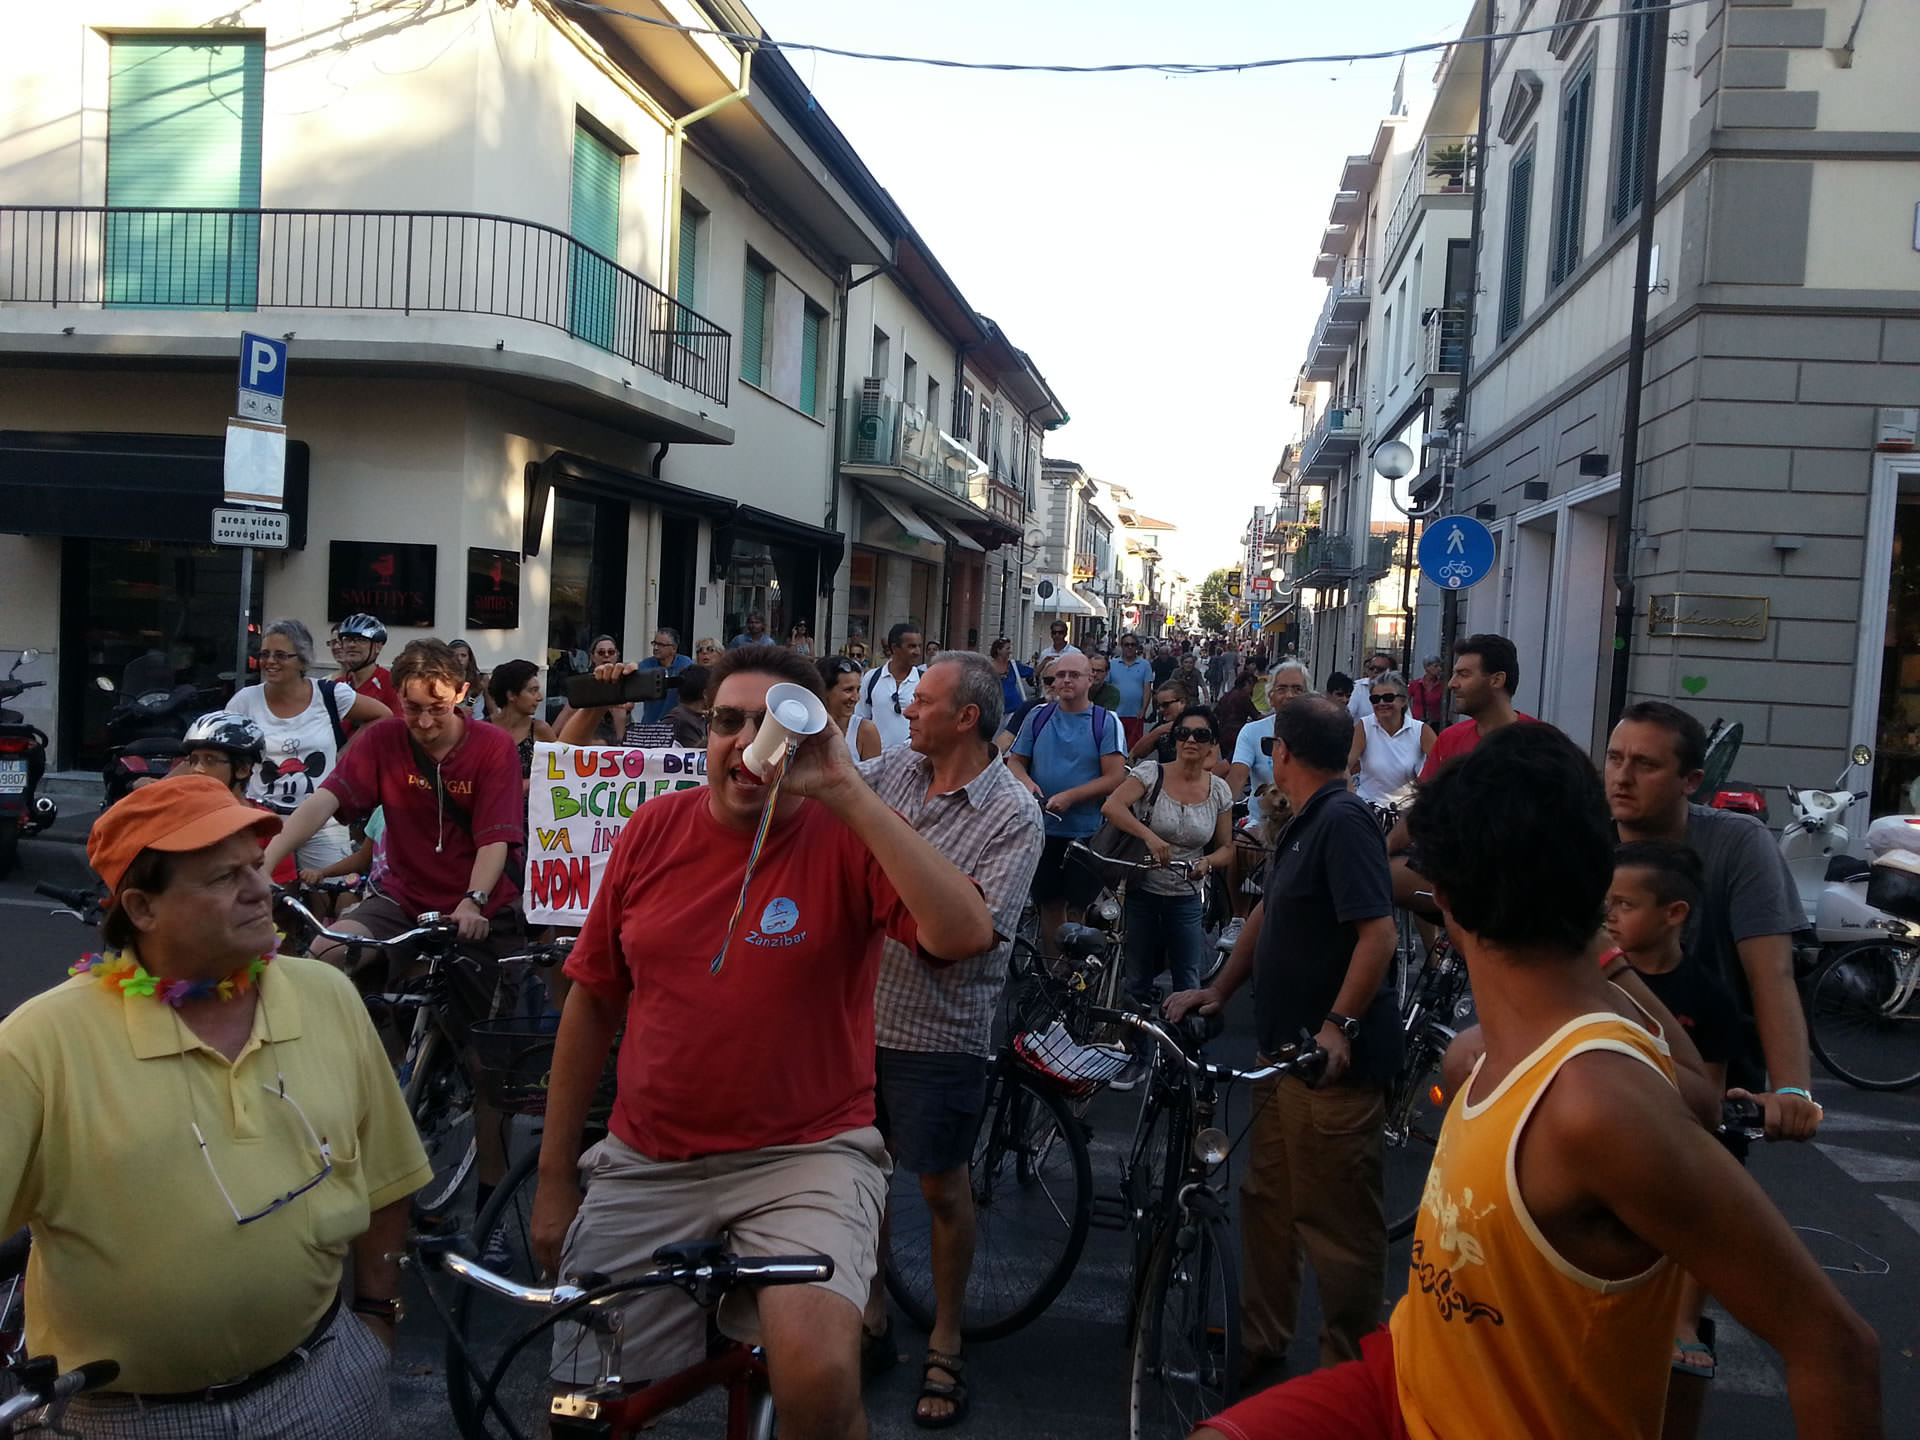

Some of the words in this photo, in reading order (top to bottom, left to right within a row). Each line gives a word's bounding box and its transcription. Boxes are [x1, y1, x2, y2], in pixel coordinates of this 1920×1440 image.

[250, 340, 277, 385] P
[221, 516, 246, 526] area
[251, 516, 281, 528] video
[217, 528, 283, 542] sorvegliata
[0, 773, 25, 785] 9807
[536, 827, 573, 853] VA
[531, 856, 591, 910] NON
[744, 930, 807, 947] Zanzibar
